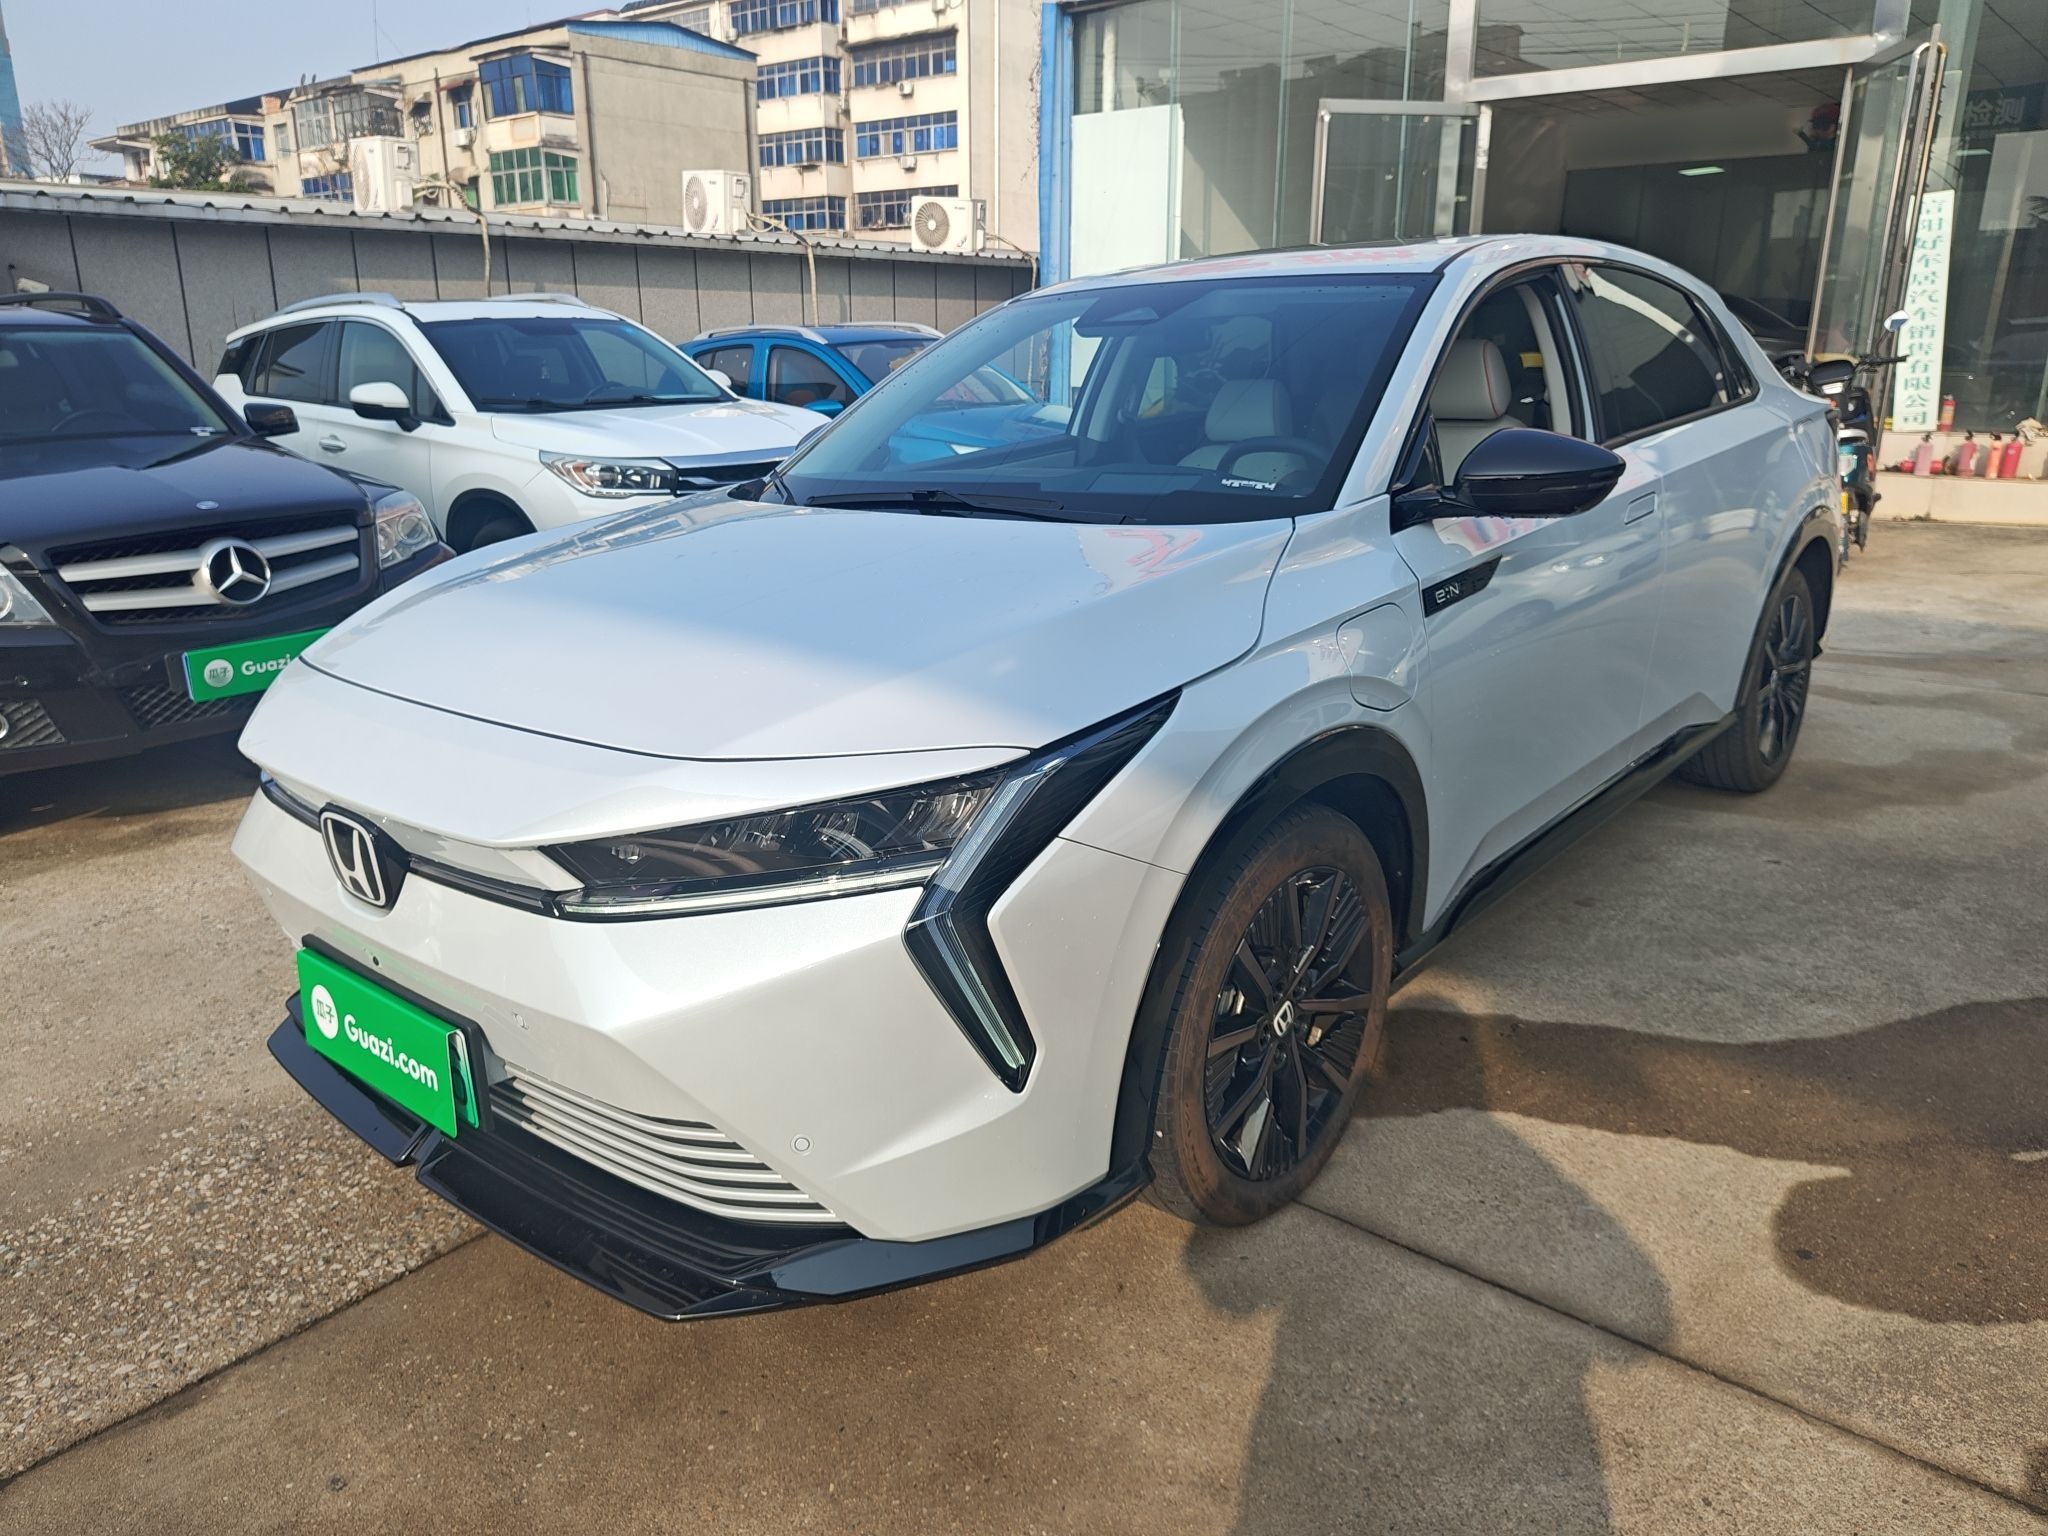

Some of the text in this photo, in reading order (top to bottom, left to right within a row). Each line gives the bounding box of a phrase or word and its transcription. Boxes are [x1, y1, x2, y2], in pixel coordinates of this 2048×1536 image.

[1964, 97, 2026, 128] 检测
[316, 998, 335, 1024] 瓜子
[343, 1014, 439, 1092] Guazi.com
